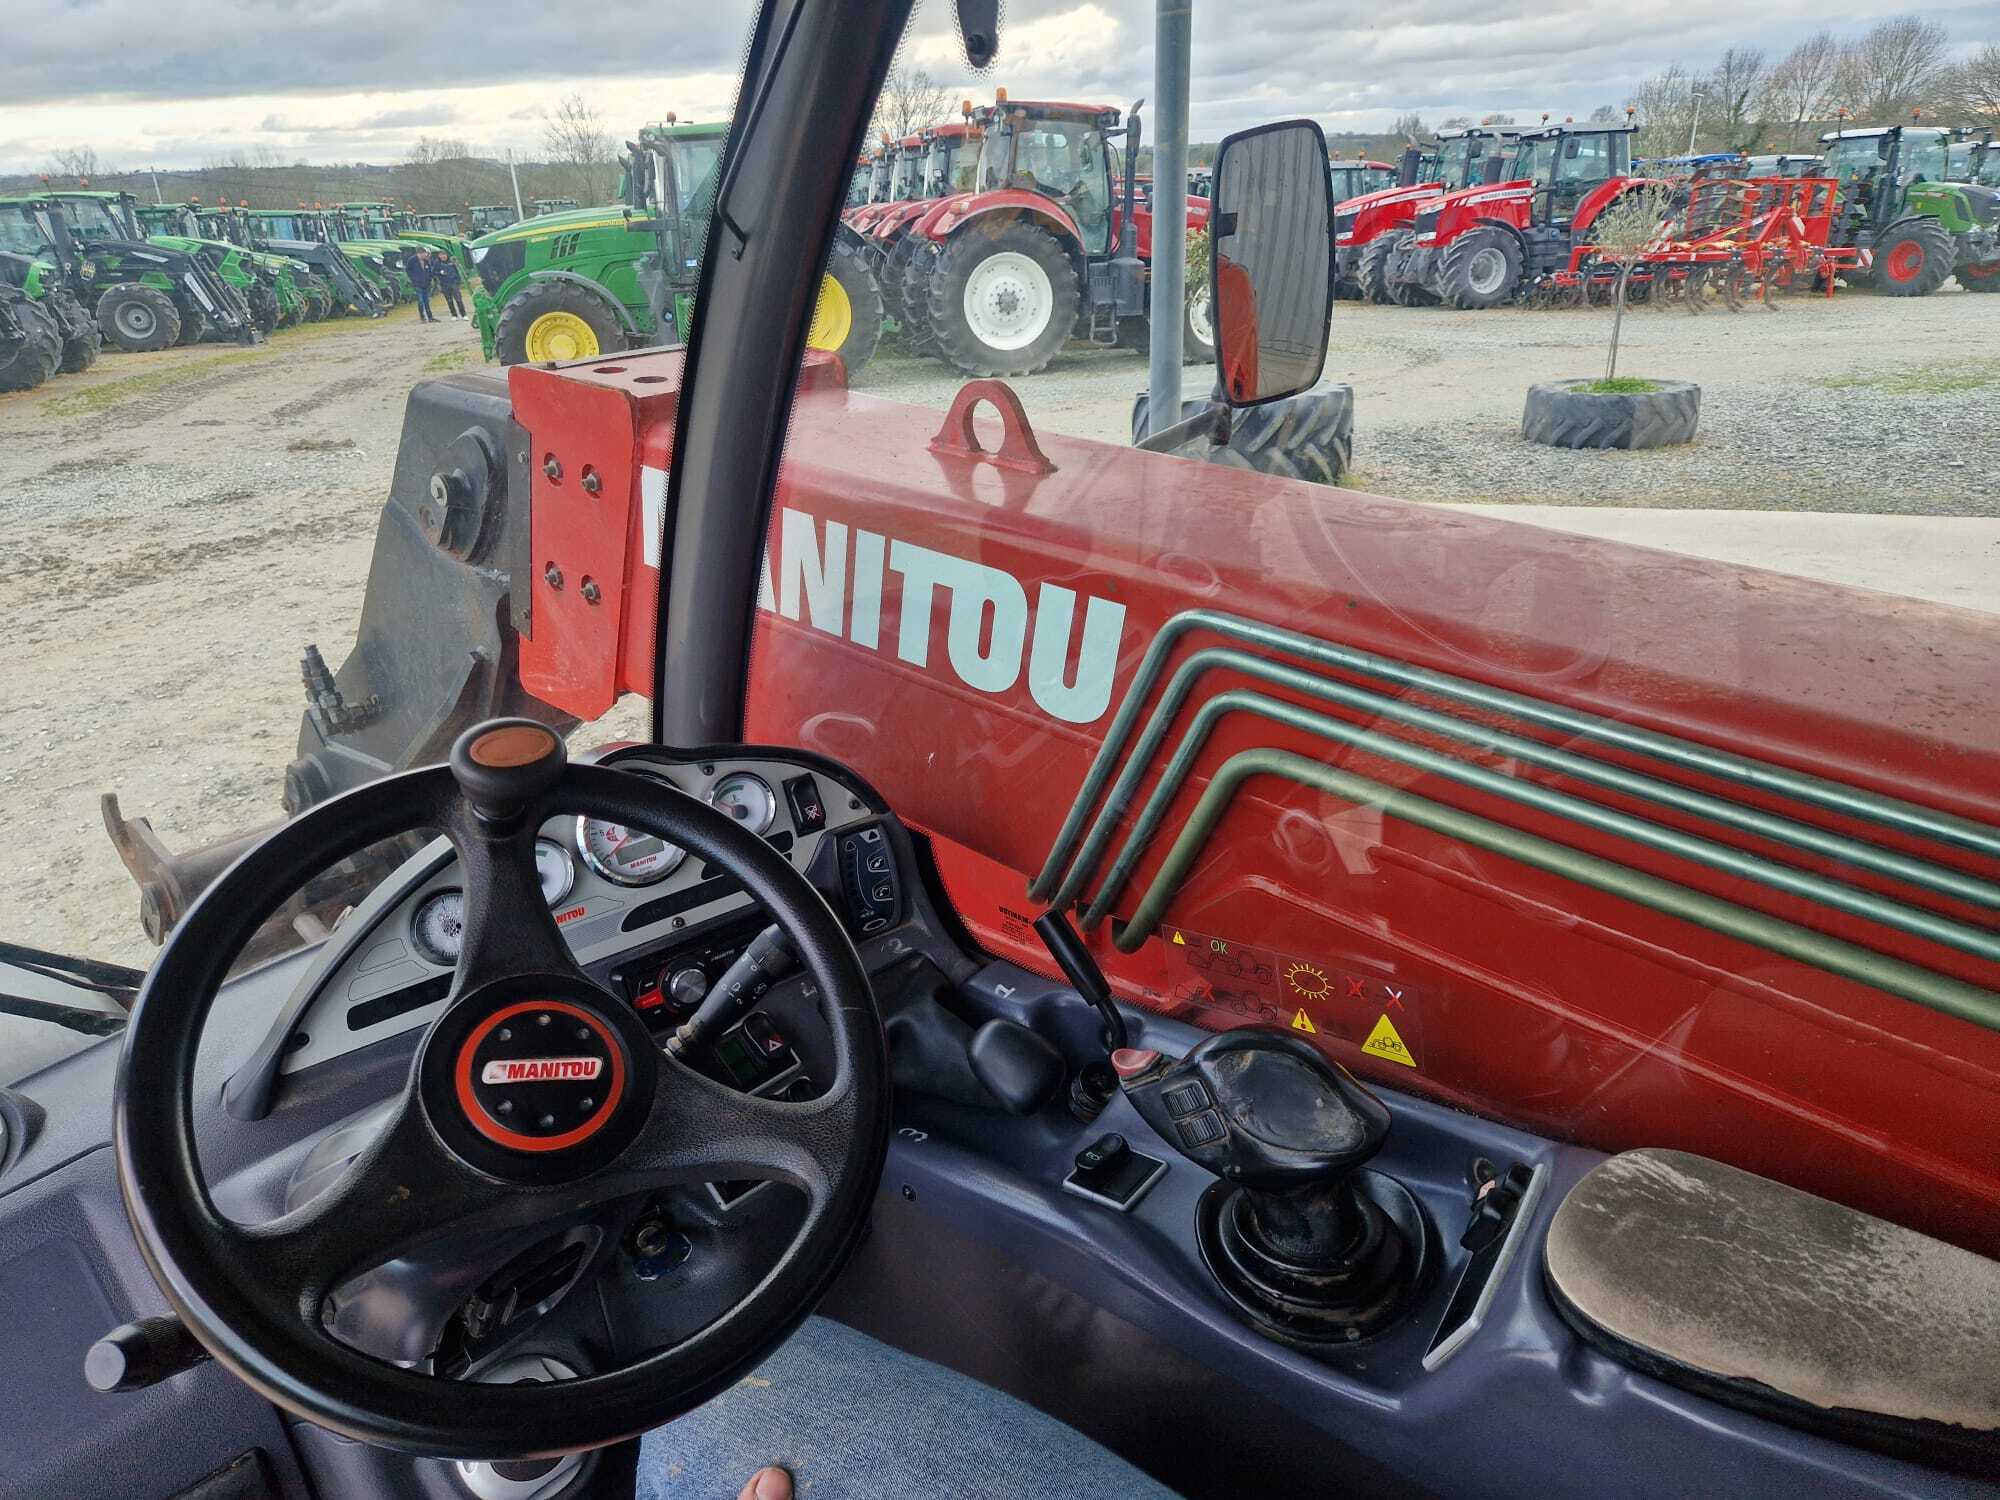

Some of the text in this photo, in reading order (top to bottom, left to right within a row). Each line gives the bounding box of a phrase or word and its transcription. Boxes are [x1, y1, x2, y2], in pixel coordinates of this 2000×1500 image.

[641, 465, 1127, 724] NITOU
[629, 855, 657, 869] MANITOU
[555, 907, 585, 924] NITOU
[1210, 939, 1228, 954] OK
[507, 1062, 596, 1079] MANITOU
